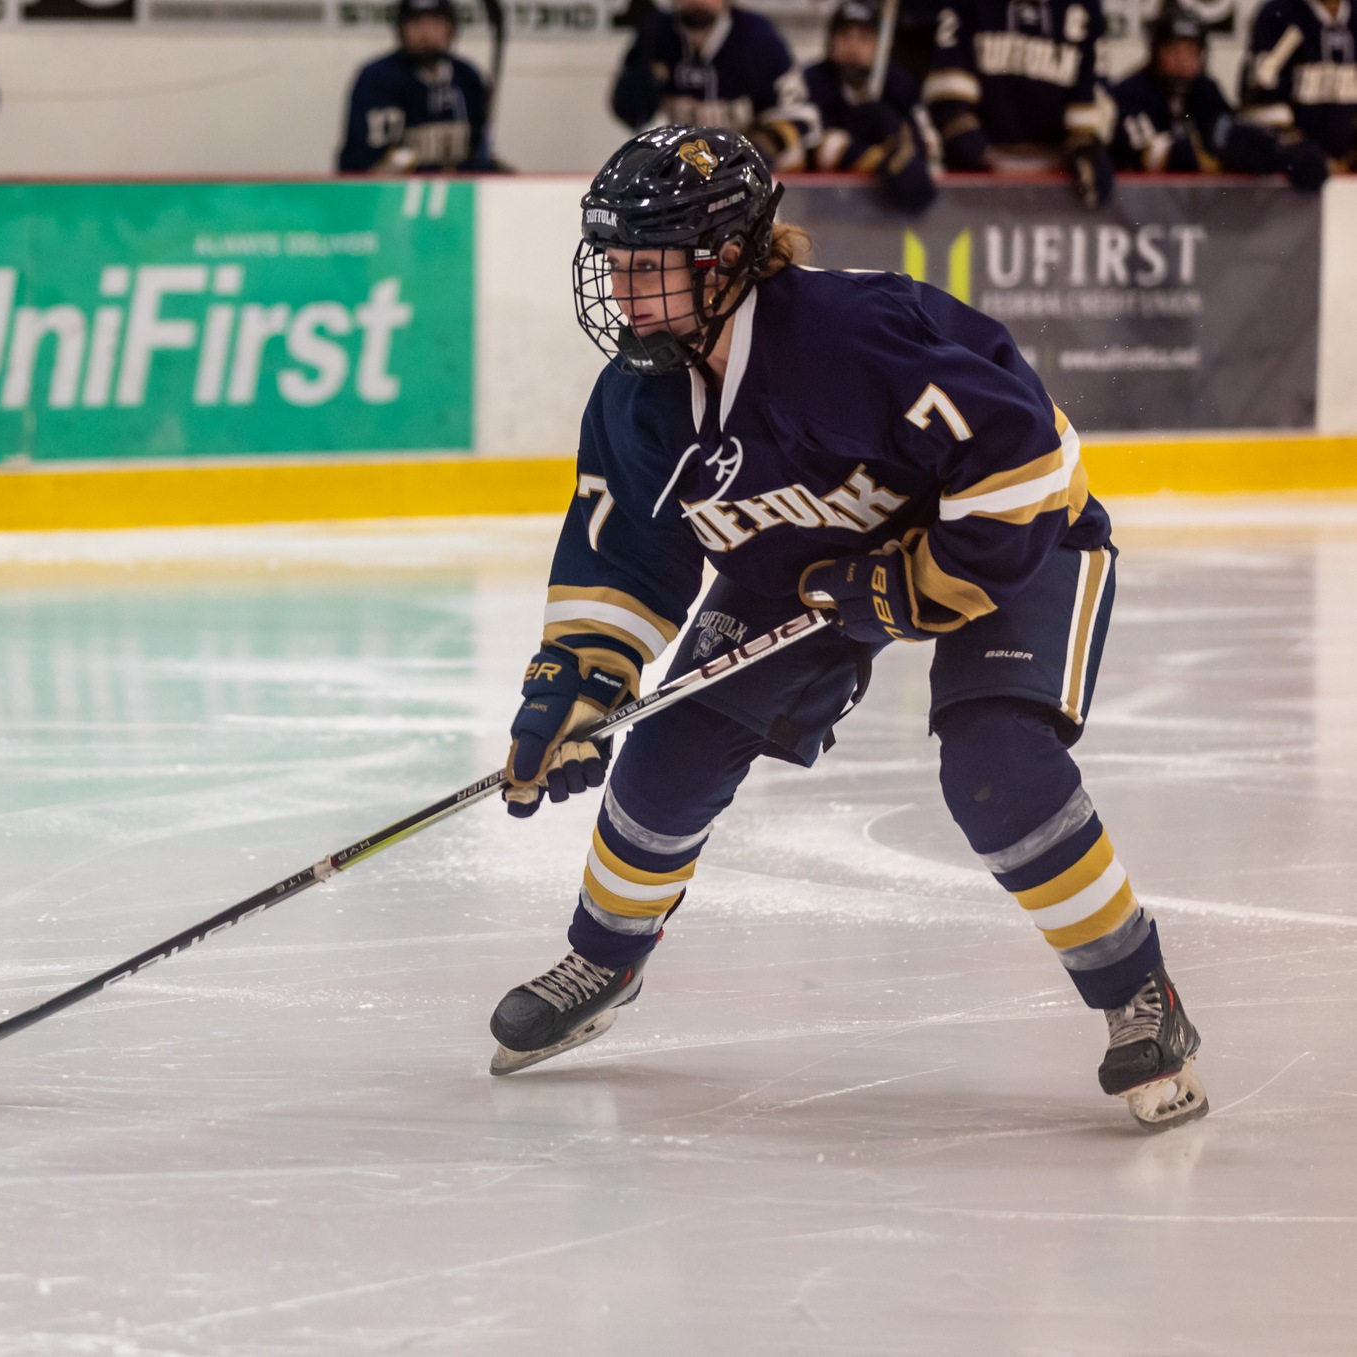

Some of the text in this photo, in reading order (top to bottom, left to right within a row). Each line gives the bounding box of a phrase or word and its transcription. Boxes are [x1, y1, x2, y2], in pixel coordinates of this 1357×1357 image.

[586, 208, 619, 228] SUFFOLK
[985, 225, 1206, 287] UFIRST
[904, 382, 973, 441] 7
[577, 472, 616, 552] 7
[679, 462, 910, 552] UFFOLK
[699, 610, 749, 645] SUFFOLK
[984, 650, 1033, 661] BAUER
